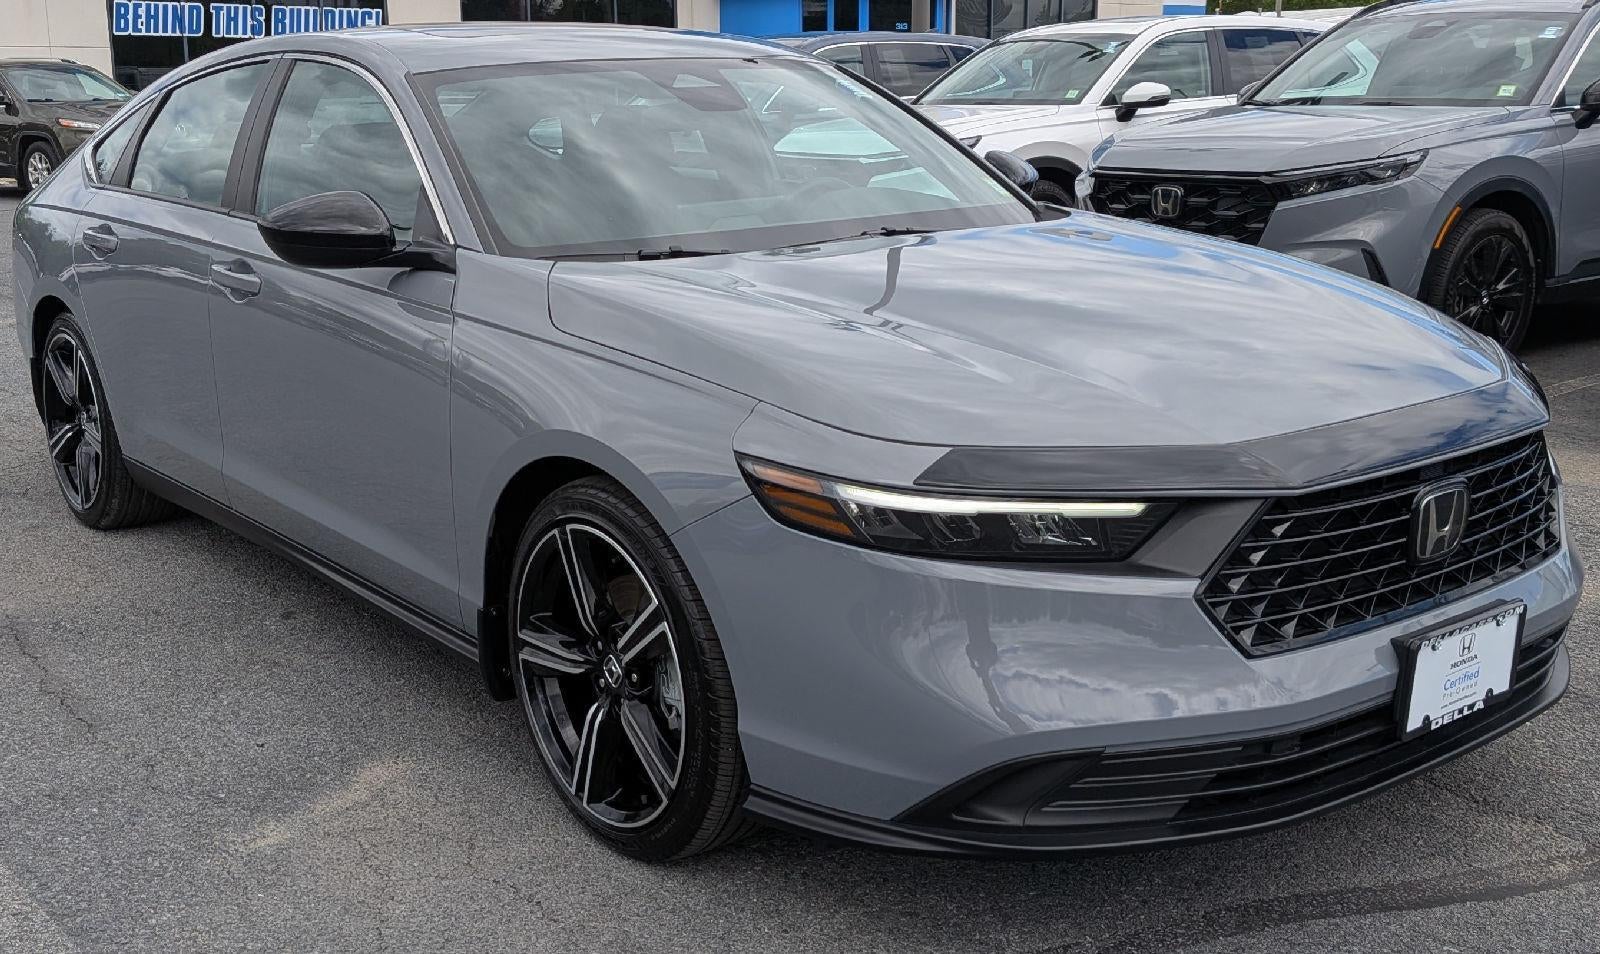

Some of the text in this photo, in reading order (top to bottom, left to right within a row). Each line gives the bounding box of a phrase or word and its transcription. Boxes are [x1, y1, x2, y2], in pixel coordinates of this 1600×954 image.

[114, 0, 382, 39] BEHIND THIS BUILDING!
[895, 22, 908, 30] 313
[1450, 654, 1478, 670] HONDA
[1443, 667, 1480, 691] Certified
[1431, 700, 1484, 731] DELLA
